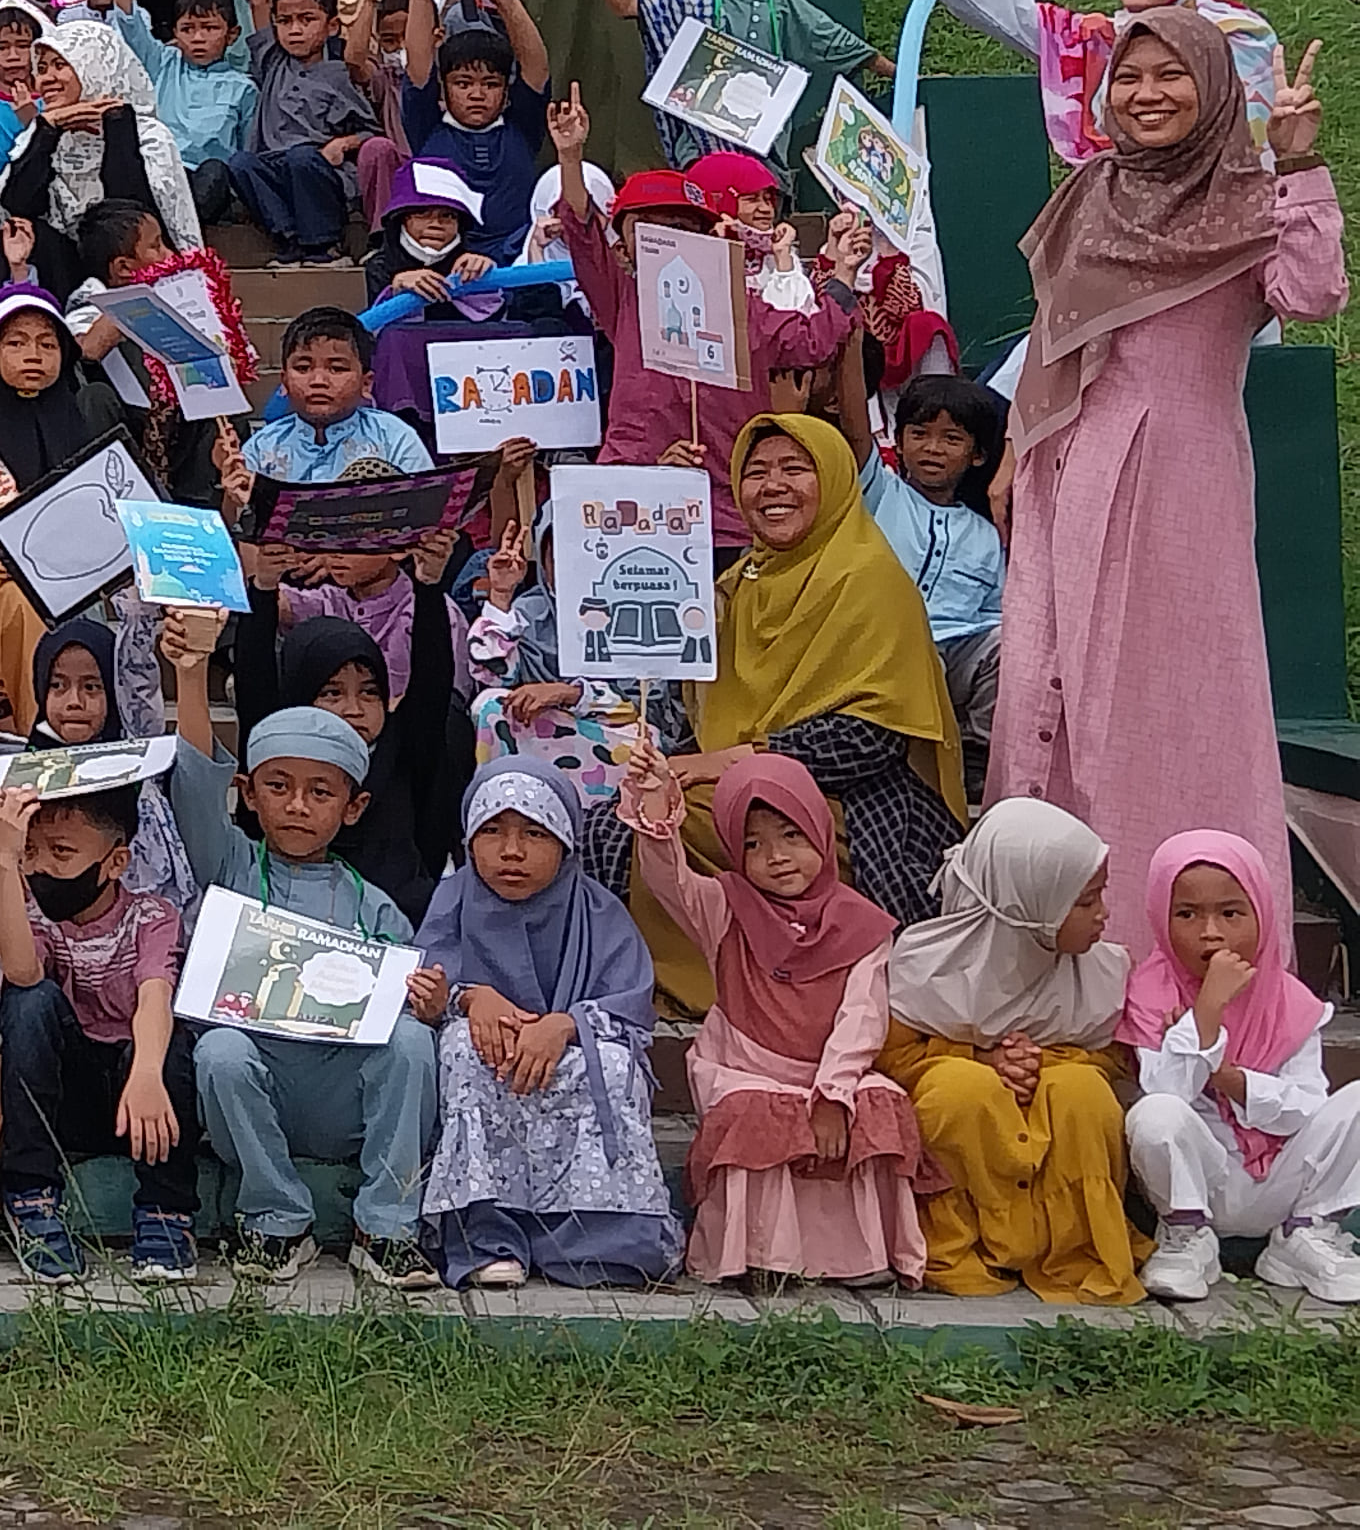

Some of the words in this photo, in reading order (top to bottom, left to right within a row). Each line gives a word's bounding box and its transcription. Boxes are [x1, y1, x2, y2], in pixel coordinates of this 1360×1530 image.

[706, 344, 716, 360] 6
[618, 564, 671, 576] Selamat
[297, 927, 382, 960] RAMADHAN
